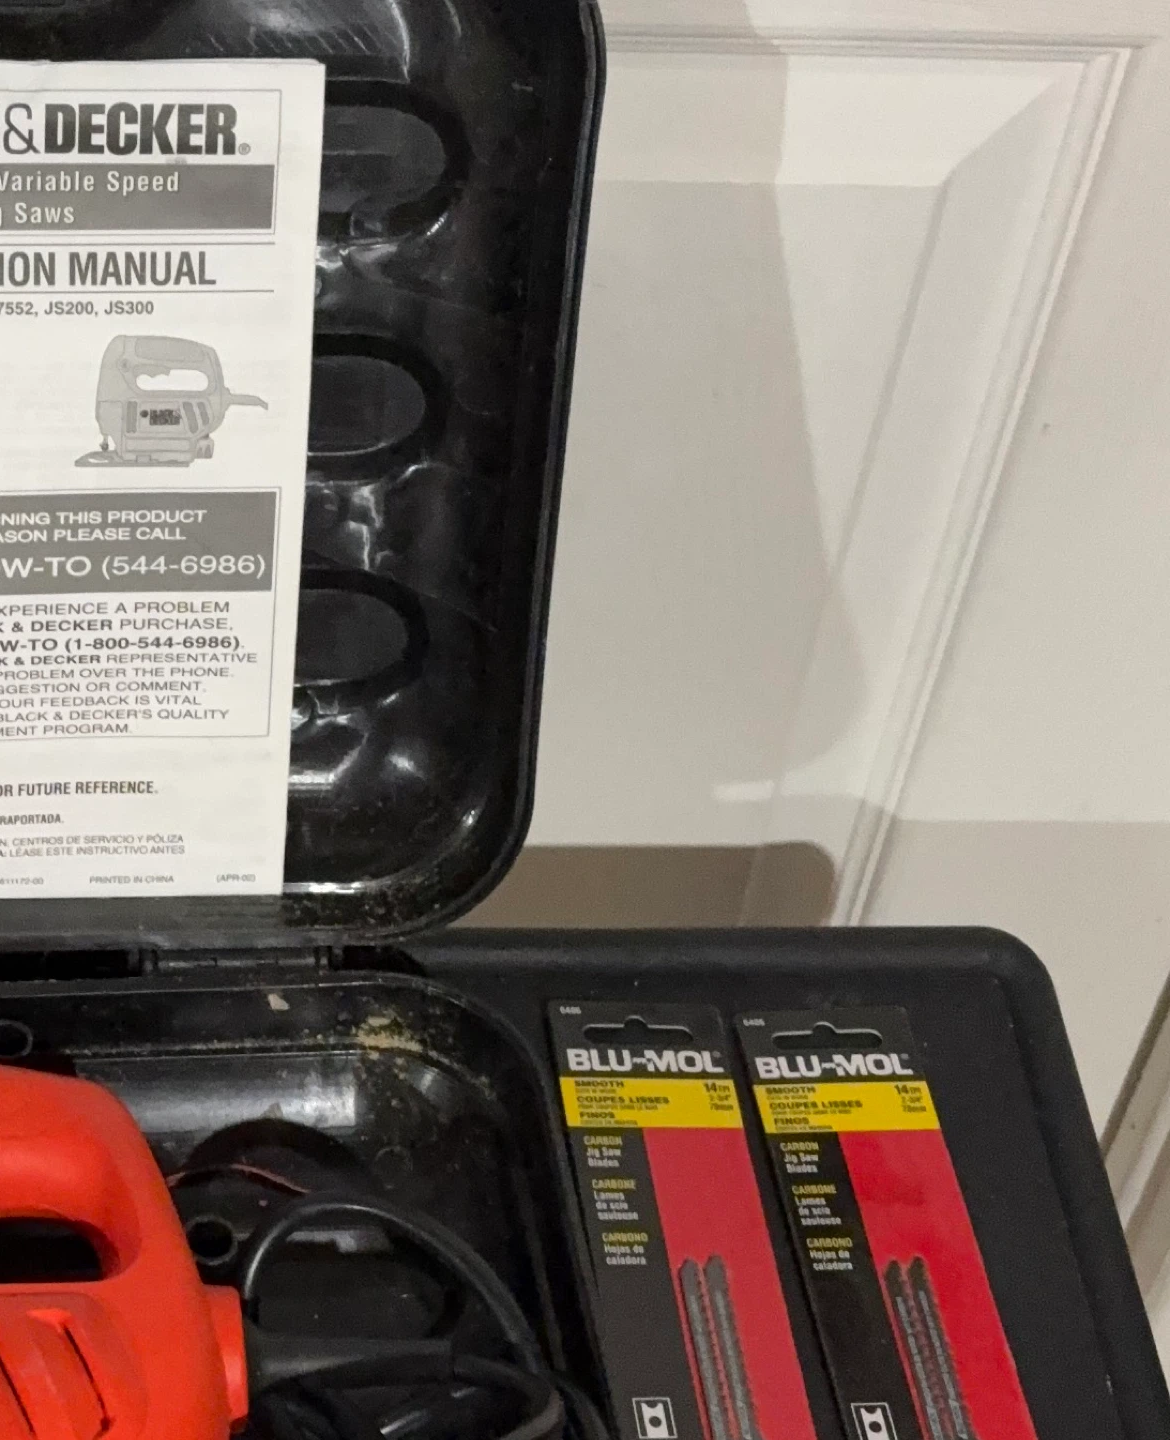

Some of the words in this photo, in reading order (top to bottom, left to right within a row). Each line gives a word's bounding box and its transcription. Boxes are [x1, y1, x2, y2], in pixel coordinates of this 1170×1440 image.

[107, 171, 179, 196] Speed
[14, 202, 74, 224] Saws
[69, 251, 216, 286] MANUAL
[44, 301, 98, 316] JS200,
[104, 301, 154, 315] JS300
[56, 512, 102, 524] THIS
[108, 510, 207, 523] PRODUCT
[54, 528, 130, 542] PLEASE
[136, 527, 186, 540] CALL
[102, 554, 265, 579] (544-6986)
[115, 602, 128, 613] A
[134, 601, 230, 613] PROBLEM
[12, 622, 23, 633] &
[31, 620, 112, 632] DECKER
[14, 657, 25, 666] &
[31, 655, 101, 666] DECKER
[107, 653, 257, 664] REPRESENTATIVE
[79, 668, 126, 678] OVER
[132, 668, 164, 678] THE
[86, 682, 110, 692] OR
[40, 696, 130, 707] FEEDBACK
[135, 695, 150, 705] IS
[155, 695, 201, 705] VITAL
[54, 712, 63, 721] &
[70, 709, 152, 721] DECKER'S
[158, 709, 229, 720] QUALITY
[18, 782, 71, 796] FUTURE
[75, 781, 158, 795] REFERENCE.
[13, 836, 63, 846] CENTROS
[66, 836, 81, 844] DE
[84, 835, 134, 844] SERVICIO
[137, 835, 144, 843] Y
[90, 875, 130, 884] PRINTED
[133, 875, 143, 883] IN
[146, 875, 174, 883] CHINA
[567, 1049, 724, 1073] BLU-MOL
[755, 1053, 913, 1079] BLU-MOL
[703, 1083, 717, 1092] 14
[766, 1086, 816, 1095] SMOOTH
[895, 1085, 908, 1095] 14
[577, 1096, 625, 1104] COUPES
[770, 1102, 818, 1110] COUPES
[822, 1100, 862, 1108] LISSES
[774, 1117, 809, 1125] FINOS
